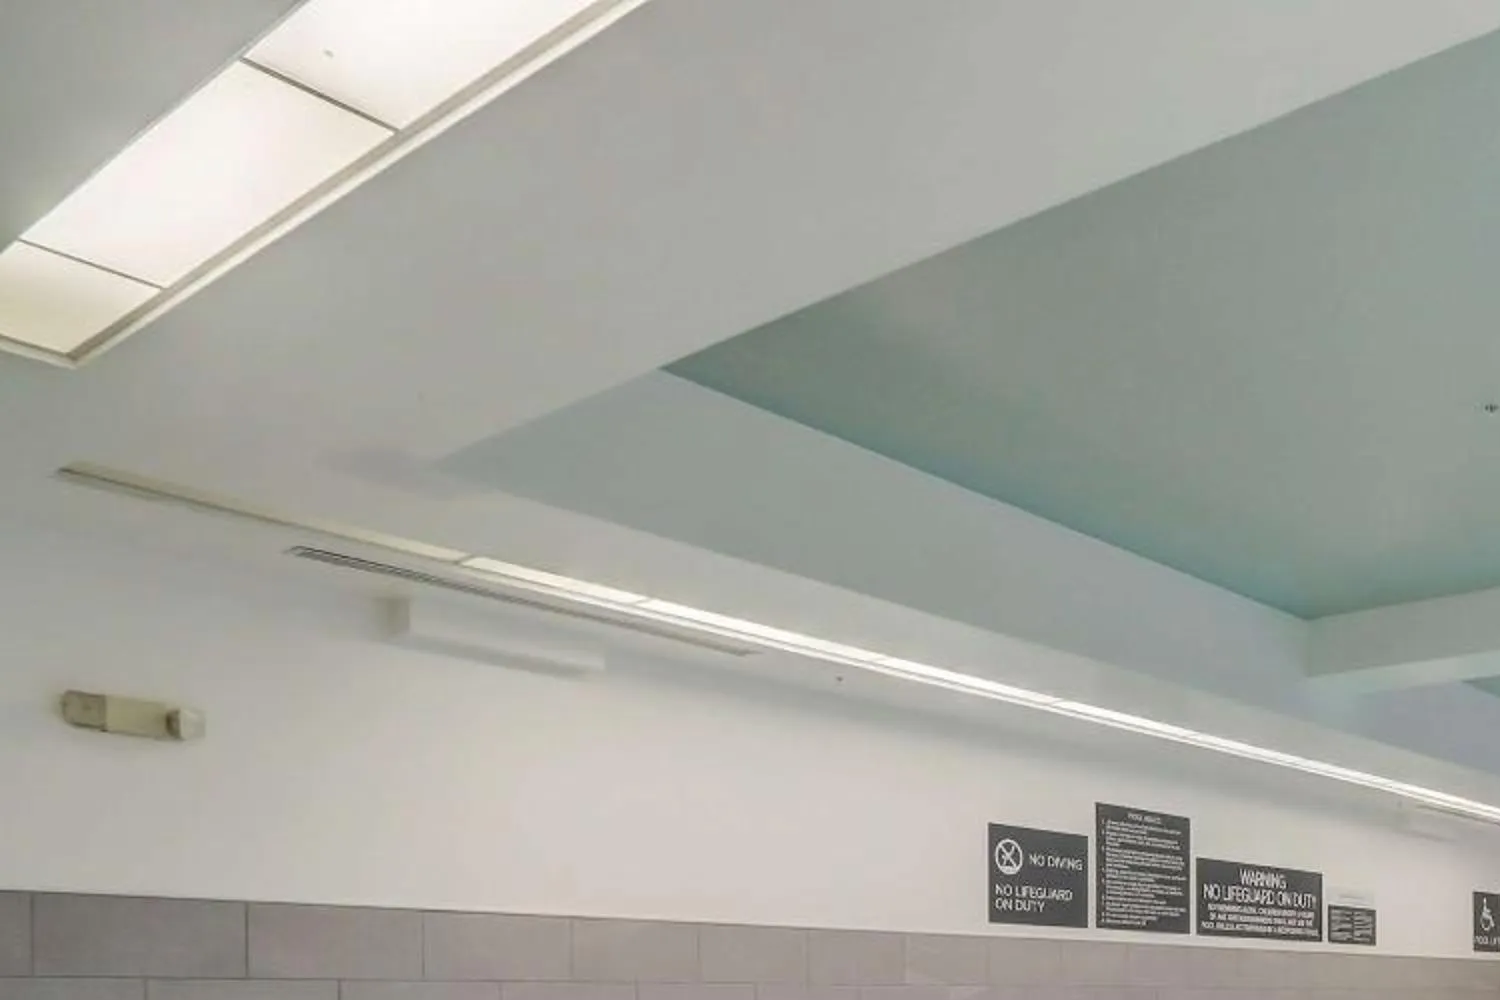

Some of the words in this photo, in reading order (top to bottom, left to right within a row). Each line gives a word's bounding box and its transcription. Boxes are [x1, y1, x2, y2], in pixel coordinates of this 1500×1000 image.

[1029, 853, 1045, 867] NO
[1047, 855, 1083, 871] DIVING
[1240, 867, 1287, 890] WARNING
[995, 883, 1013, 897] NO
[1015, 884, 1073, 901] LIFEGUARD
[1203, 882, 1220, 901] NO
[1223, 885, 1275, 905] LIFEGUARD
[1278, 891, 1292, 907] ON
[995, 898, 1013, 911] ON
[1015, 899, 1045, 912] DUTY
